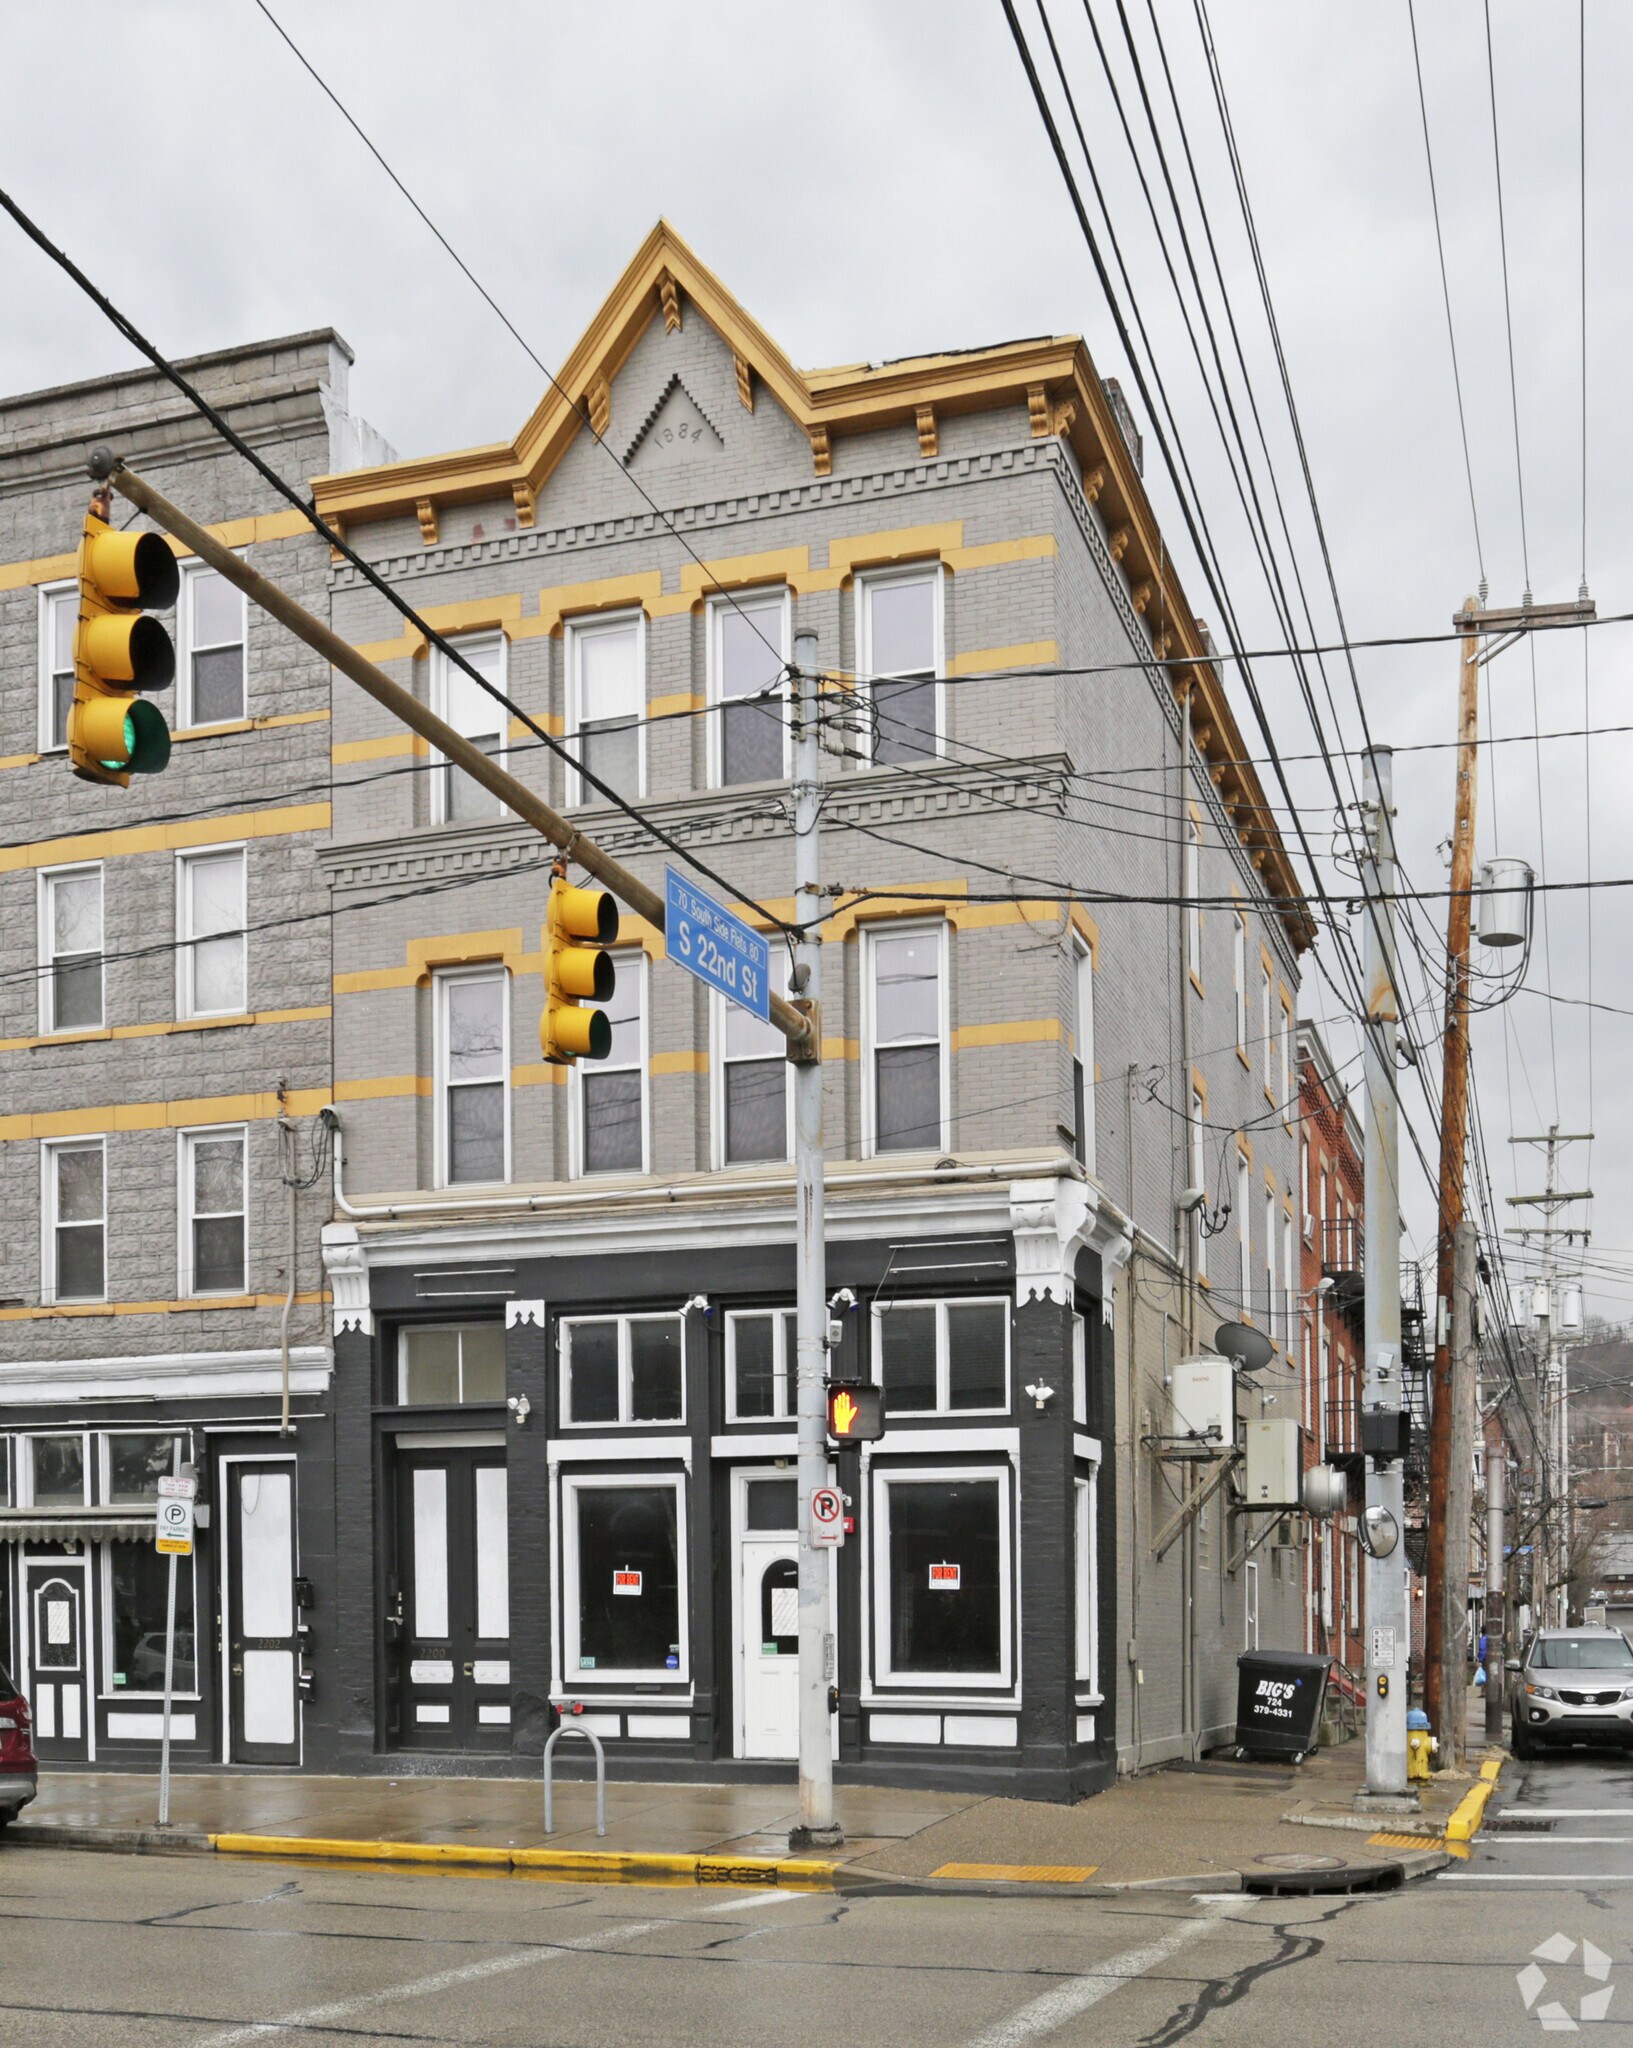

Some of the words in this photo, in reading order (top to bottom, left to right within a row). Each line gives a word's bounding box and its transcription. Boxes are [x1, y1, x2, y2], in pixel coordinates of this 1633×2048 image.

[654, 422, 703, 450] 1884
[678, 889, 687, 909] 70
[691, 901, 712, 928] South
[713, 916, 729, 940] Side
[731, 928, 747, 954] Flats
[749, 943, 759, 963] 80
[678, 920, 691, 956] S
[697, 934, 736, 988] 22nd
[741, 965, 758, 1004] St
[171, 1508, 181, 1521] P
[820, 1497, 834, 1517] P
[257, 1638, 281, 1649] 2202
[420, 1647, 446, 1659] 2200
[1255, 1679, 1296, 1700] BIG'S
[1267, 1697, 1283, 1707] 724
[1253, 1704, 1293, 1719] 379-4331
